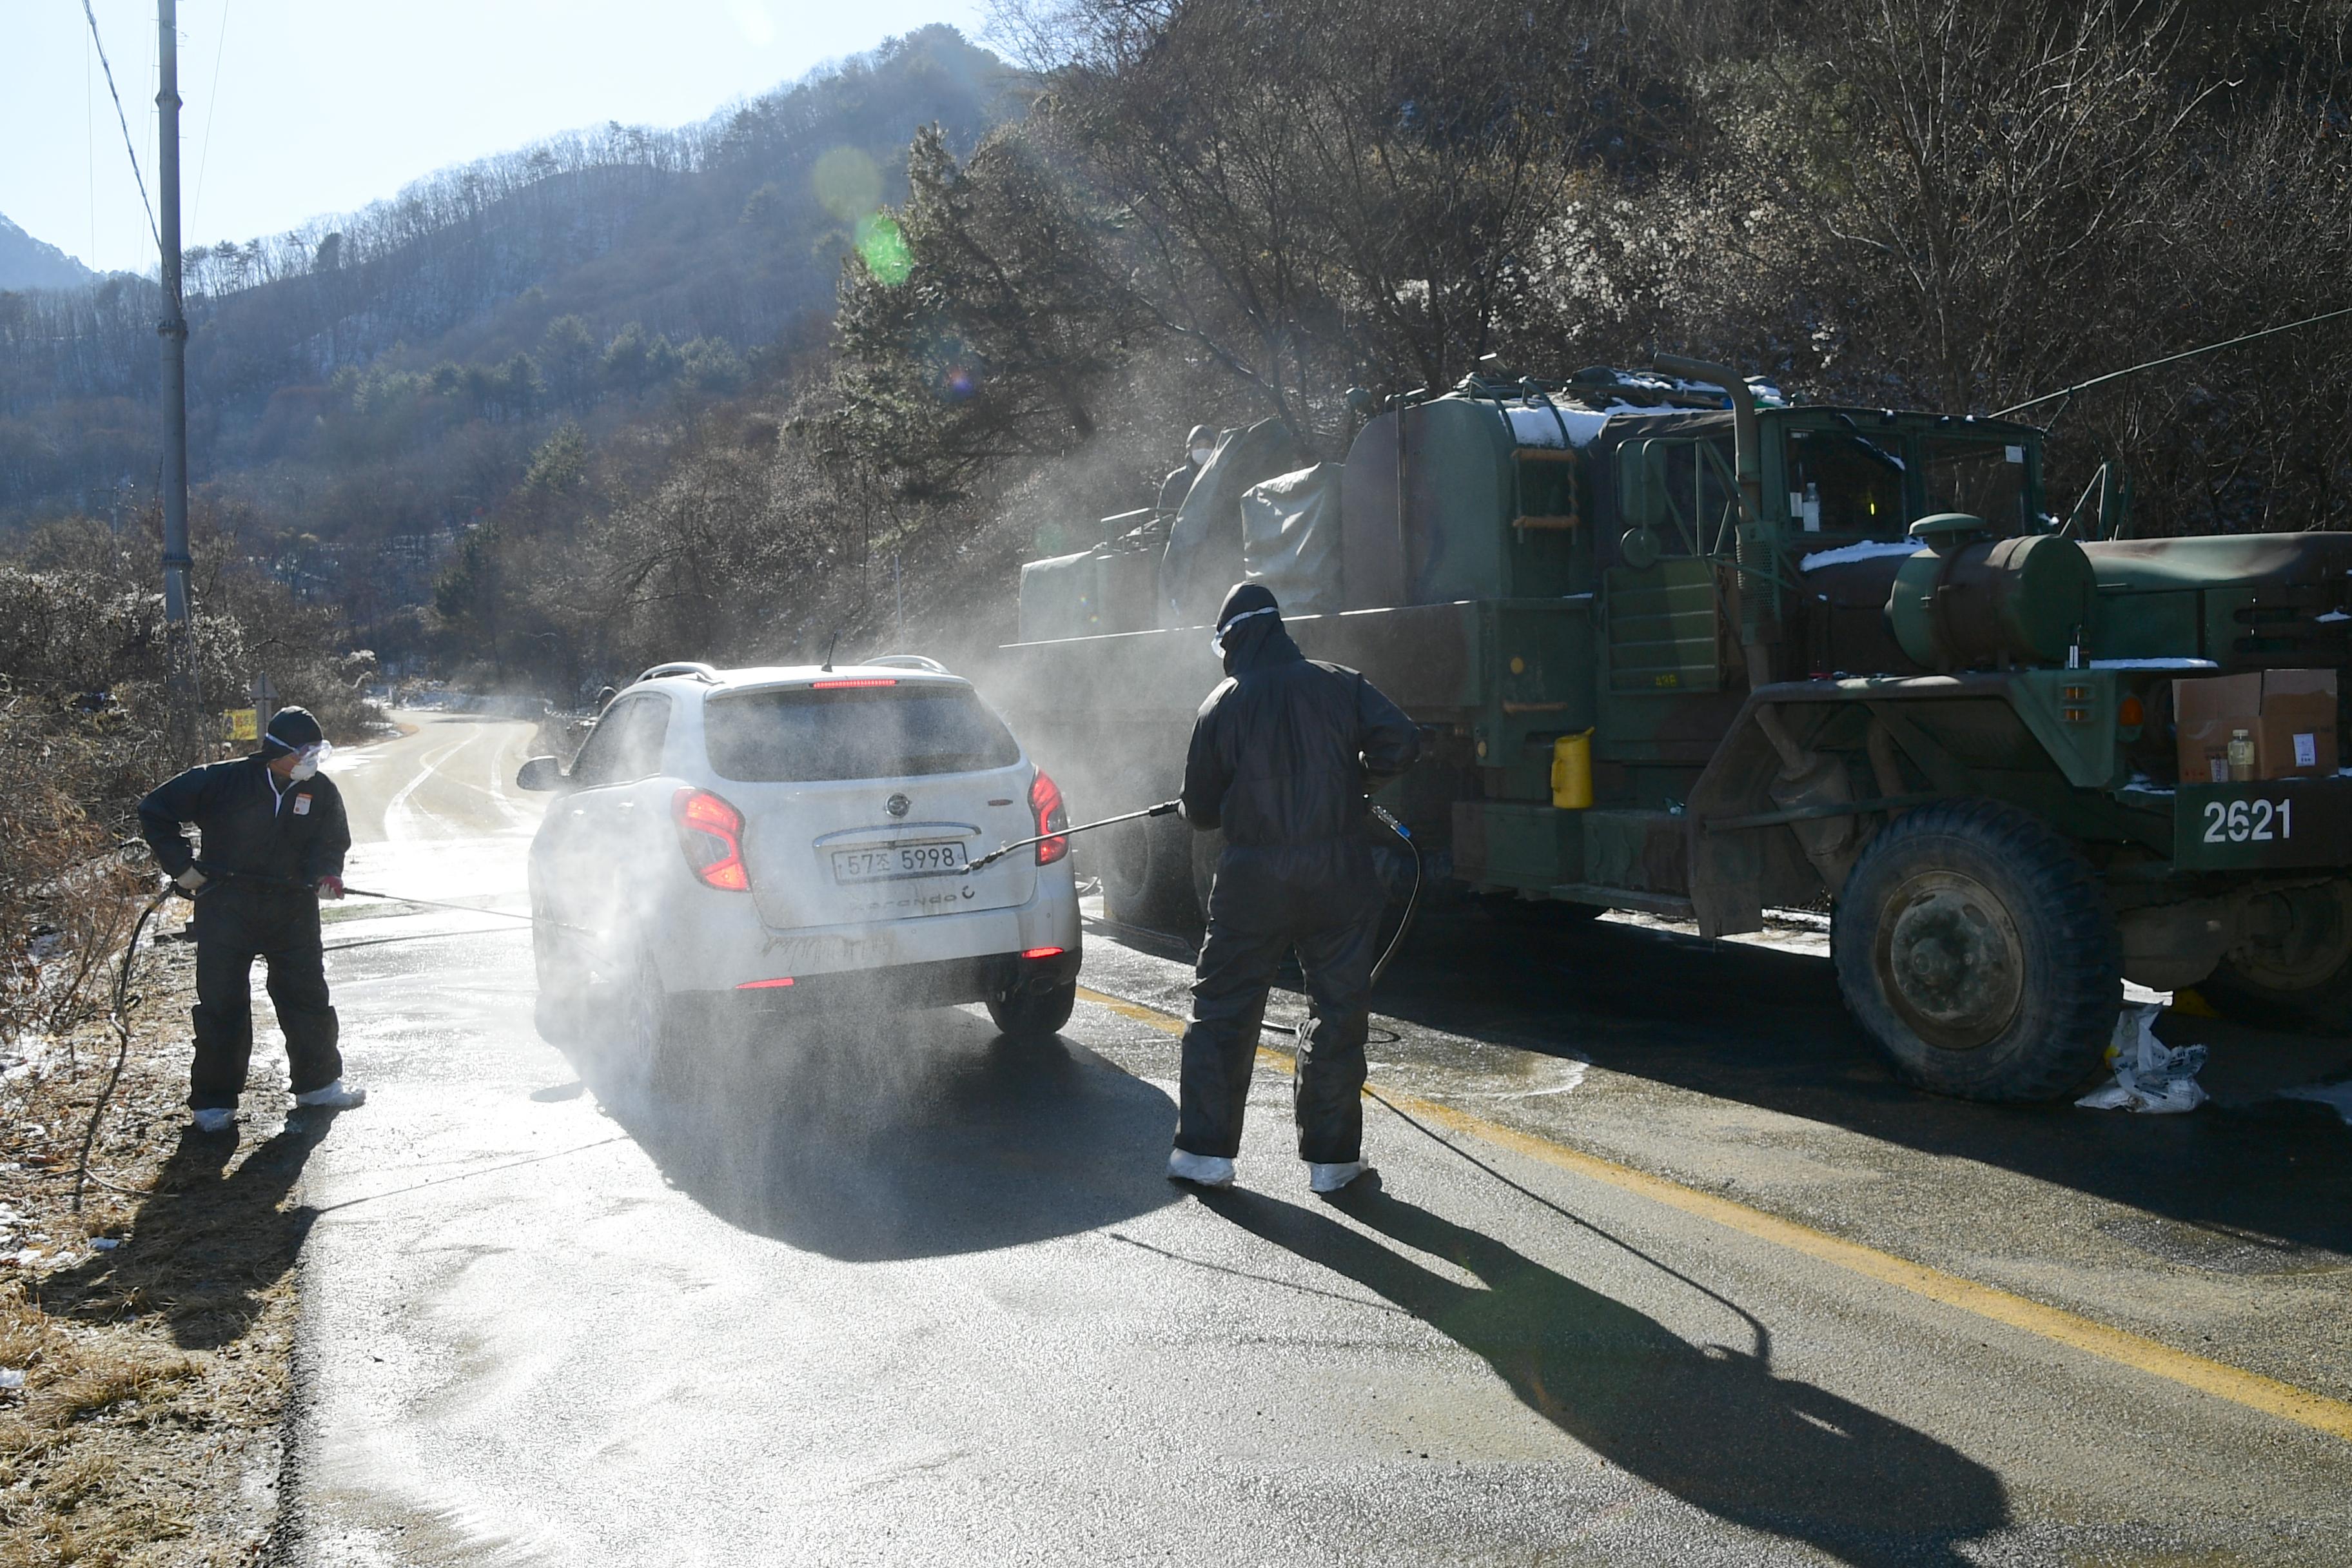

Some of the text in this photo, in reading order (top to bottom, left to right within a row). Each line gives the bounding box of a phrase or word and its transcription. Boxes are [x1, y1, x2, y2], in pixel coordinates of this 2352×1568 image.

[2203, 798, 2290, 843] 2621
[848, 847, 954, 875] 57조 5998
